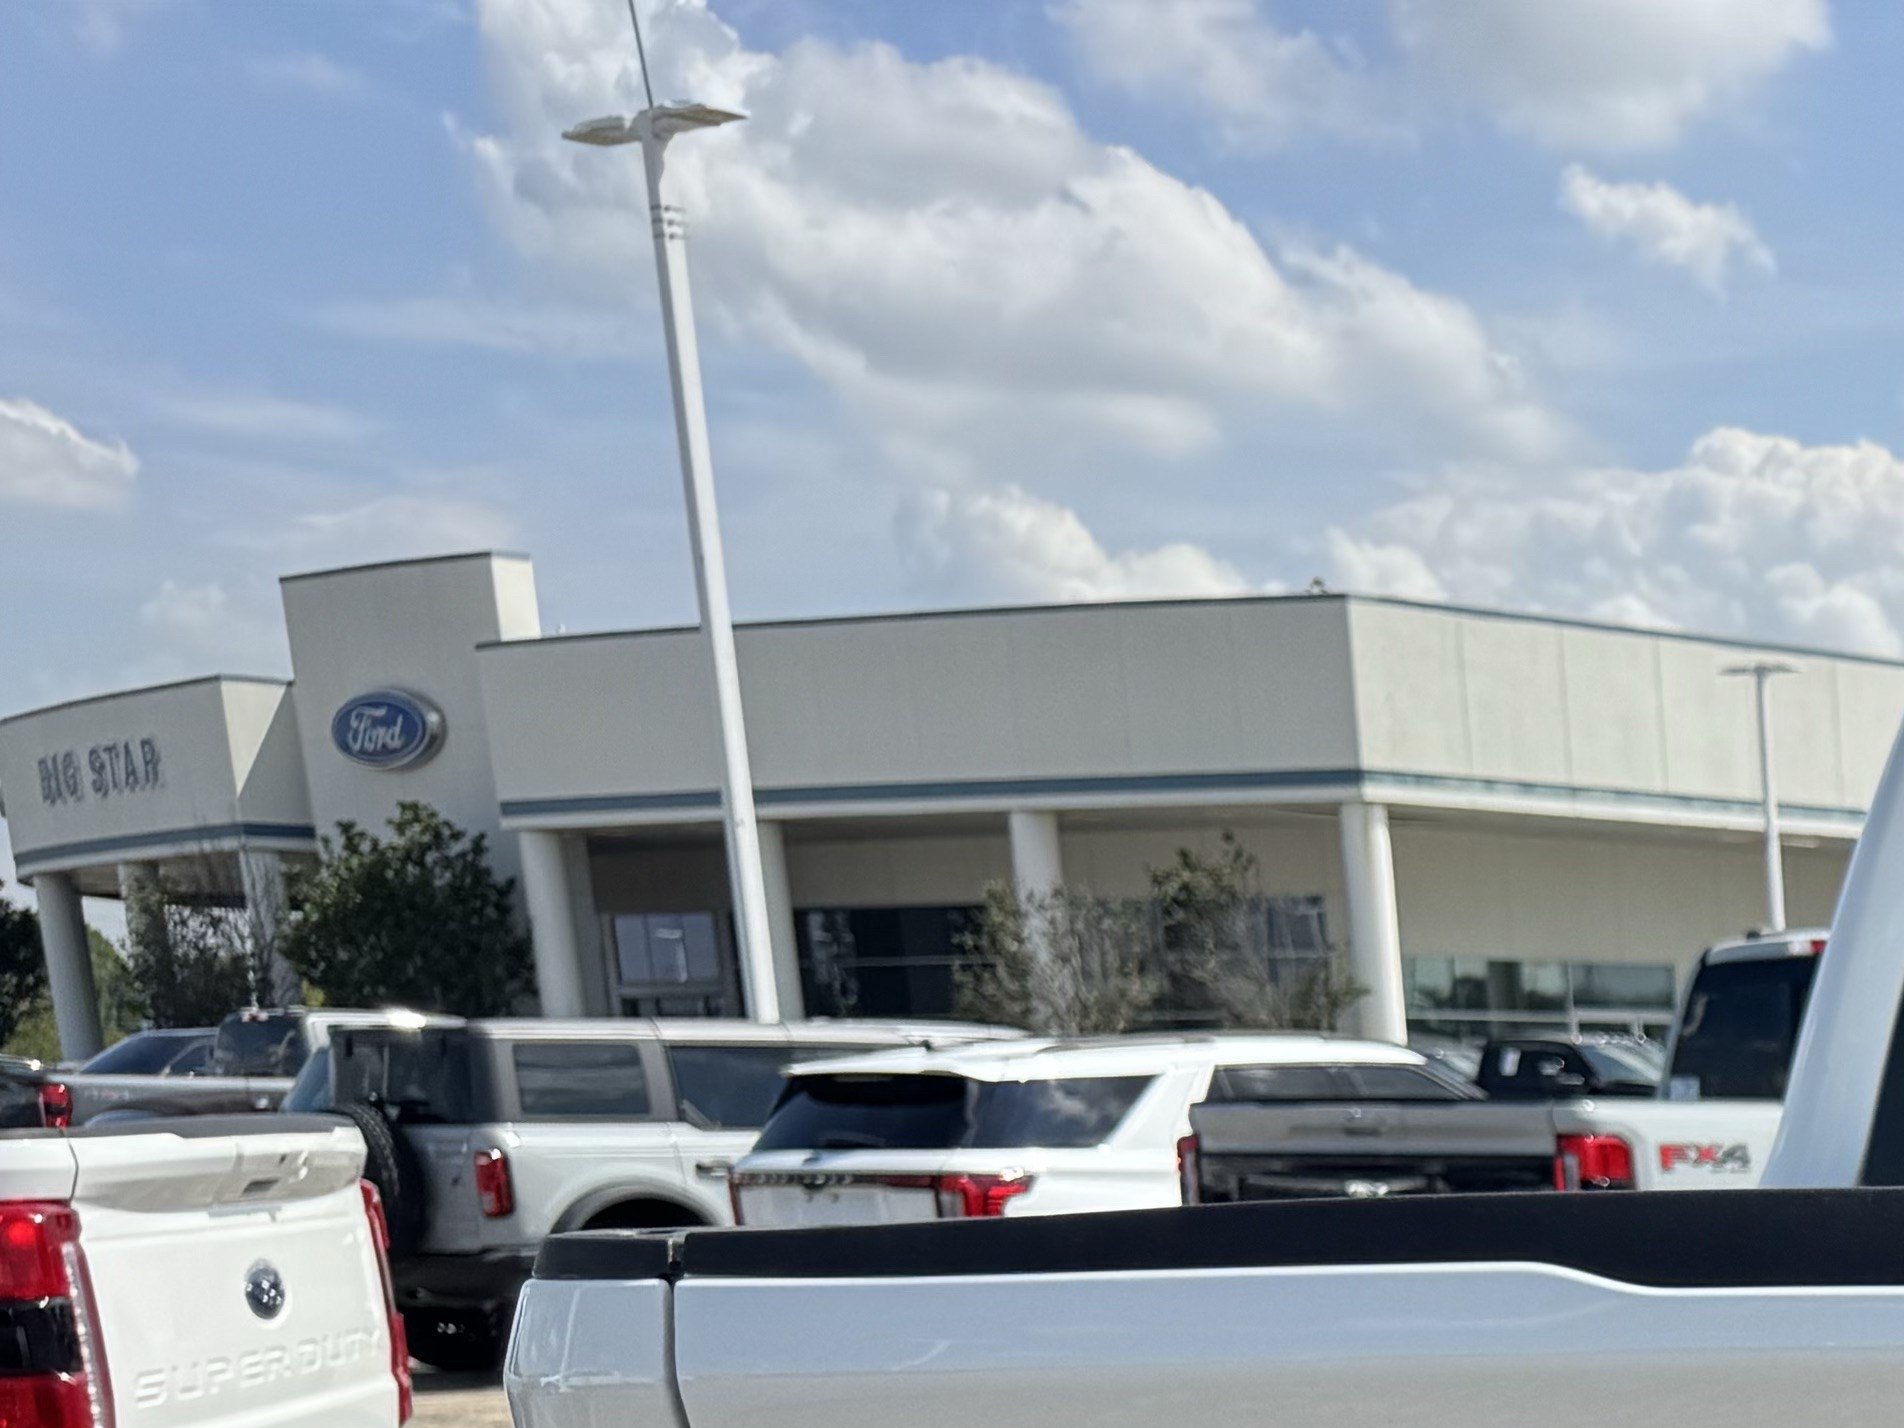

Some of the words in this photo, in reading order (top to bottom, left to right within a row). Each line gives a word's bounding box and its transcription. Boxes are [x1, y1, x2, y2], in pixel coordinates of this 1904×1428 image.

[346, 704, 404, 753] Ford
[38, 750, 82, 804] BIG
[88, 737, 161, 798] STAR
[1659, 1143, 1750, 1174] FX4
[133, 1345, 292, 1409] SUPER
[296, 1326, 382, 1377] DUTY
